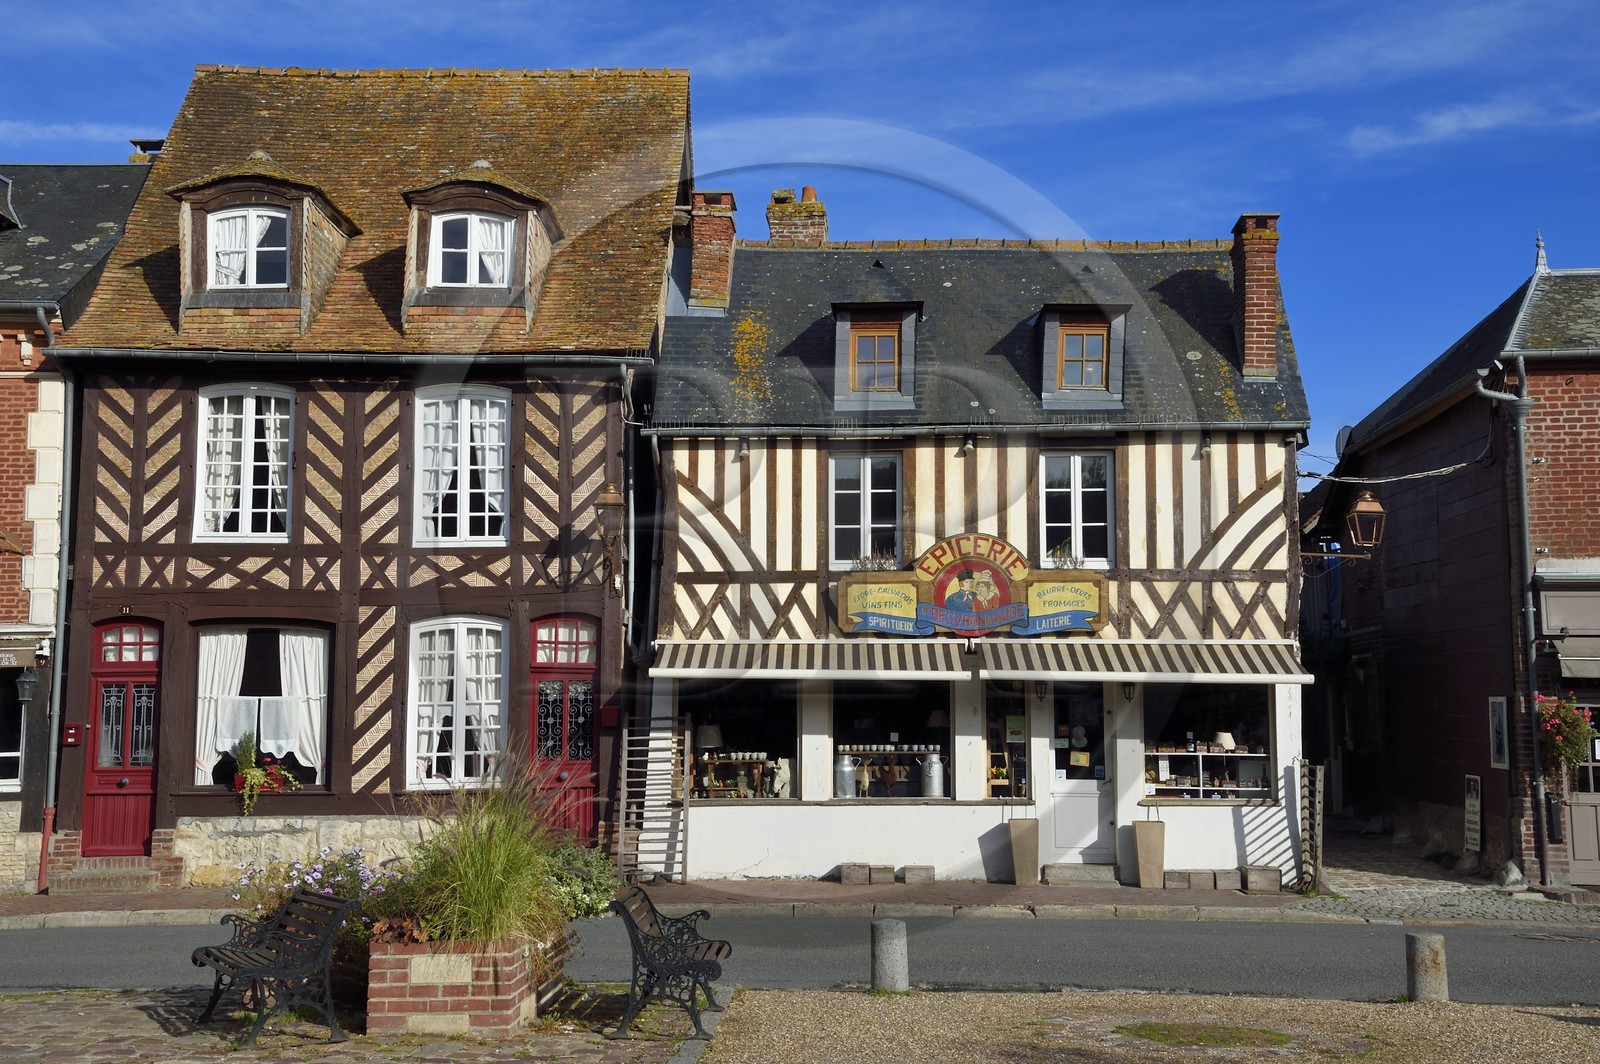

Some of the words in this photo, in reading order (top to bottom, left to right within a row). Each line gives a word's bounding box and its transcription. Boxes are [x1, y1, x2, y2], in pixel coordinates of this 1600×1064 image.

[917, 535, 1028, 578] EPICERIE
[861, 601, 882, 609] VINS
[884, 601, 903, 609] FINS
[1042, 600, 1085, 608] FROMAGES
[123, 606, 130, 614] 11
[868, 616, 914, 632] SPIRITUEUX
[1036, 615, 1072, 630] LAITERIE
